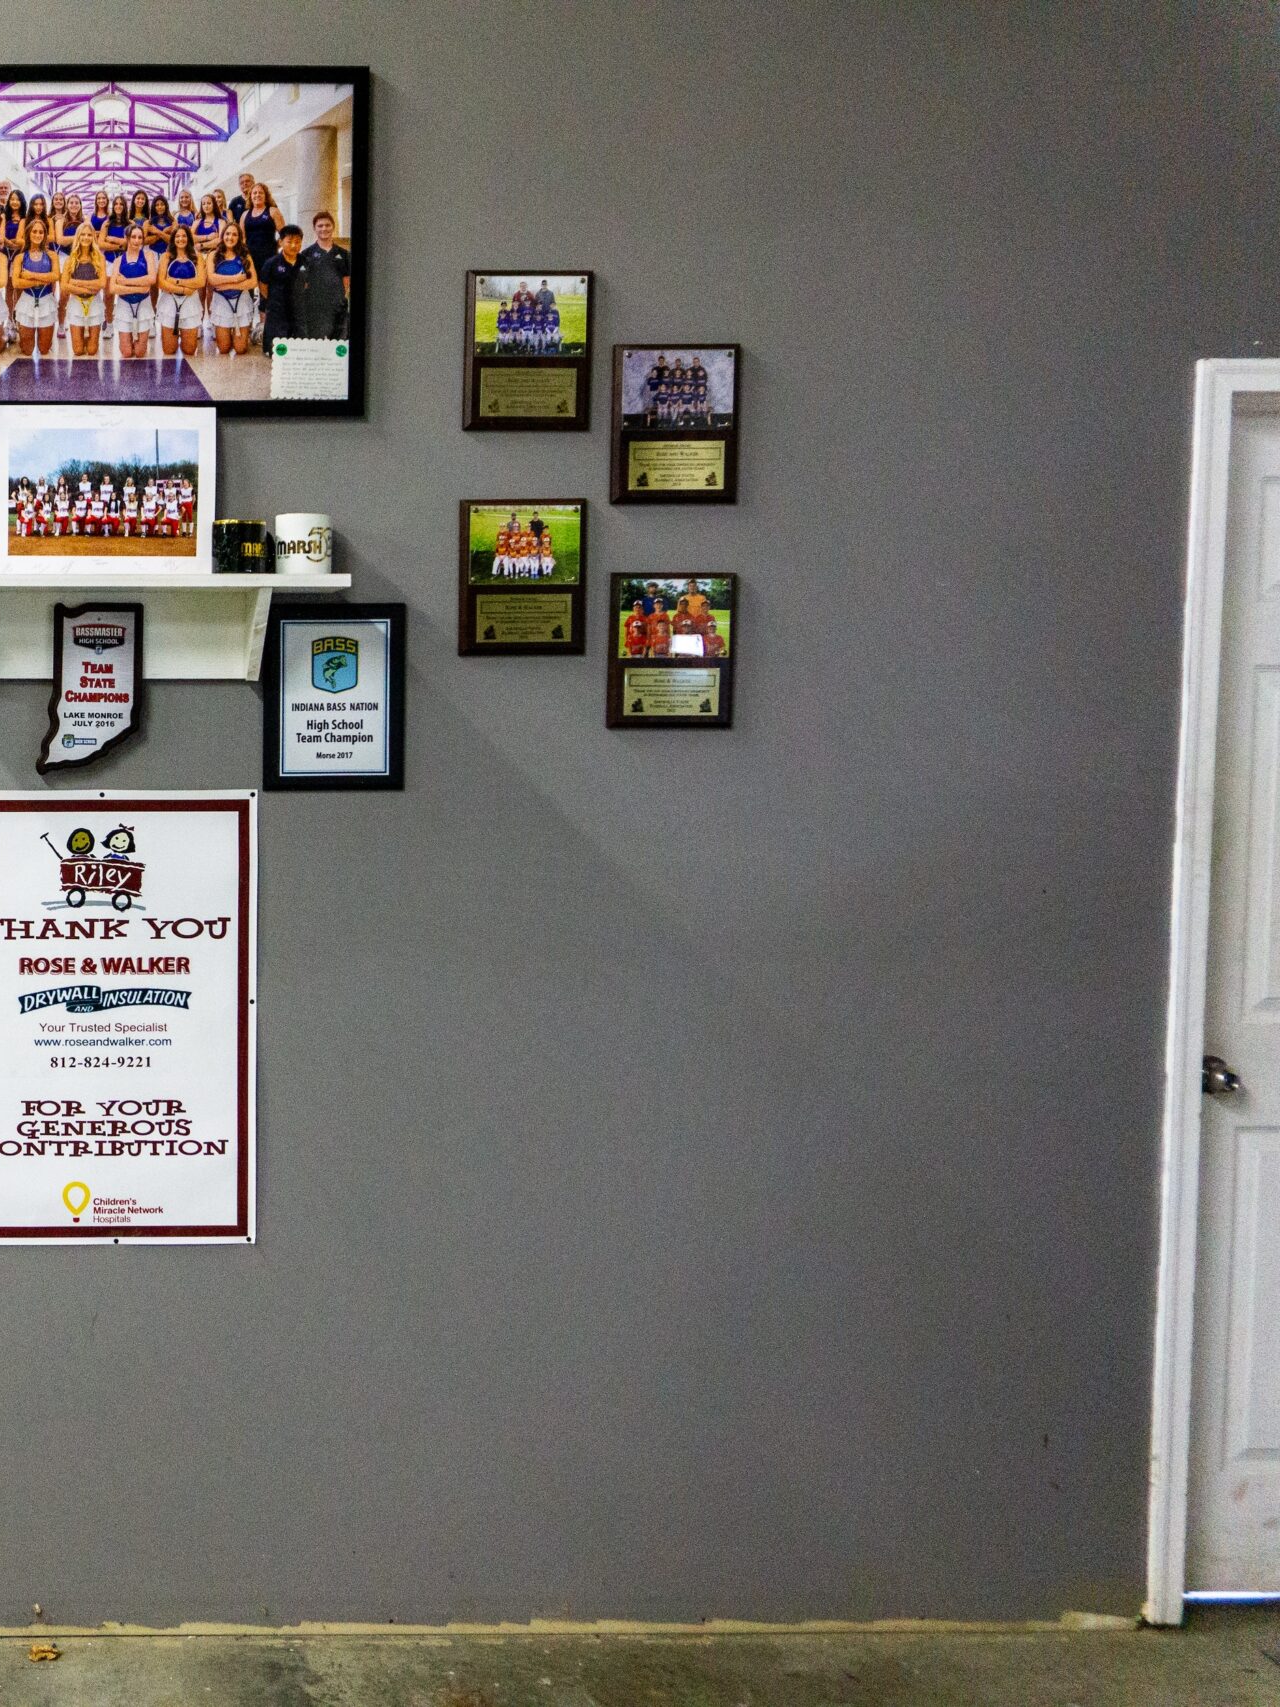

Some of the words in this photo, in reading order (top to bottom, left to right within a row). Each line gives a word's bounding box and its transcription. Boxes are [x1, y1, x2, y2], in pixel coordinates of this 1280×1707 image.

[276, 540, 322, 555] MARSH
[75, 627, 123, 637] BASSMASTER
[82, 661, 113, 674] TEAM
[79, 675, 116, 688] STATE
[64, 689, 130, 703] CHAMPIONS
[291, 702, 325, 712] INDIANA
[326, 702, 347, 712] BASS
[349, 702, 379, 711] NATION
[95, 720, 115, 728] 2016
[306, 719, 329, 732] High
[331, 719, 363, 730] School
[296, 732, 322, 743] Team
[324, 732, 374, 745] Champion
[74, 864, 131, 891] Riley
[142, 917, 231, 939] YOU
[19, 957, 76, 976] ROSE
[80, 957, 97, 975] &
[100, 957, 191, 976] WALKER
[23, 986, 100, 1012] DRYWALL
[102, 990, 188, 1008] INSULATION
[39, 1023, 65, 1032] Your
[69, 1023, 111, 1032] Trusted
[114, 1023, 168, 1034] Specialist
[34, 1037, 172, 1046] www.roseandwalker.com
[50, 1056, 152, 1068] 812-824-9221
[21, 1100, 85, 1117] FOR
[96, 1099, 187, 1117] YOUR
[16, 1119, 193, 1139] GENEROUS
[93, 1197, 137, 1205] Children's
[93, 1206, 125, 1214] Miracle
[127, 1206, 164, 1214] Network
[93, 1215, 131, 1224] Hospitals
